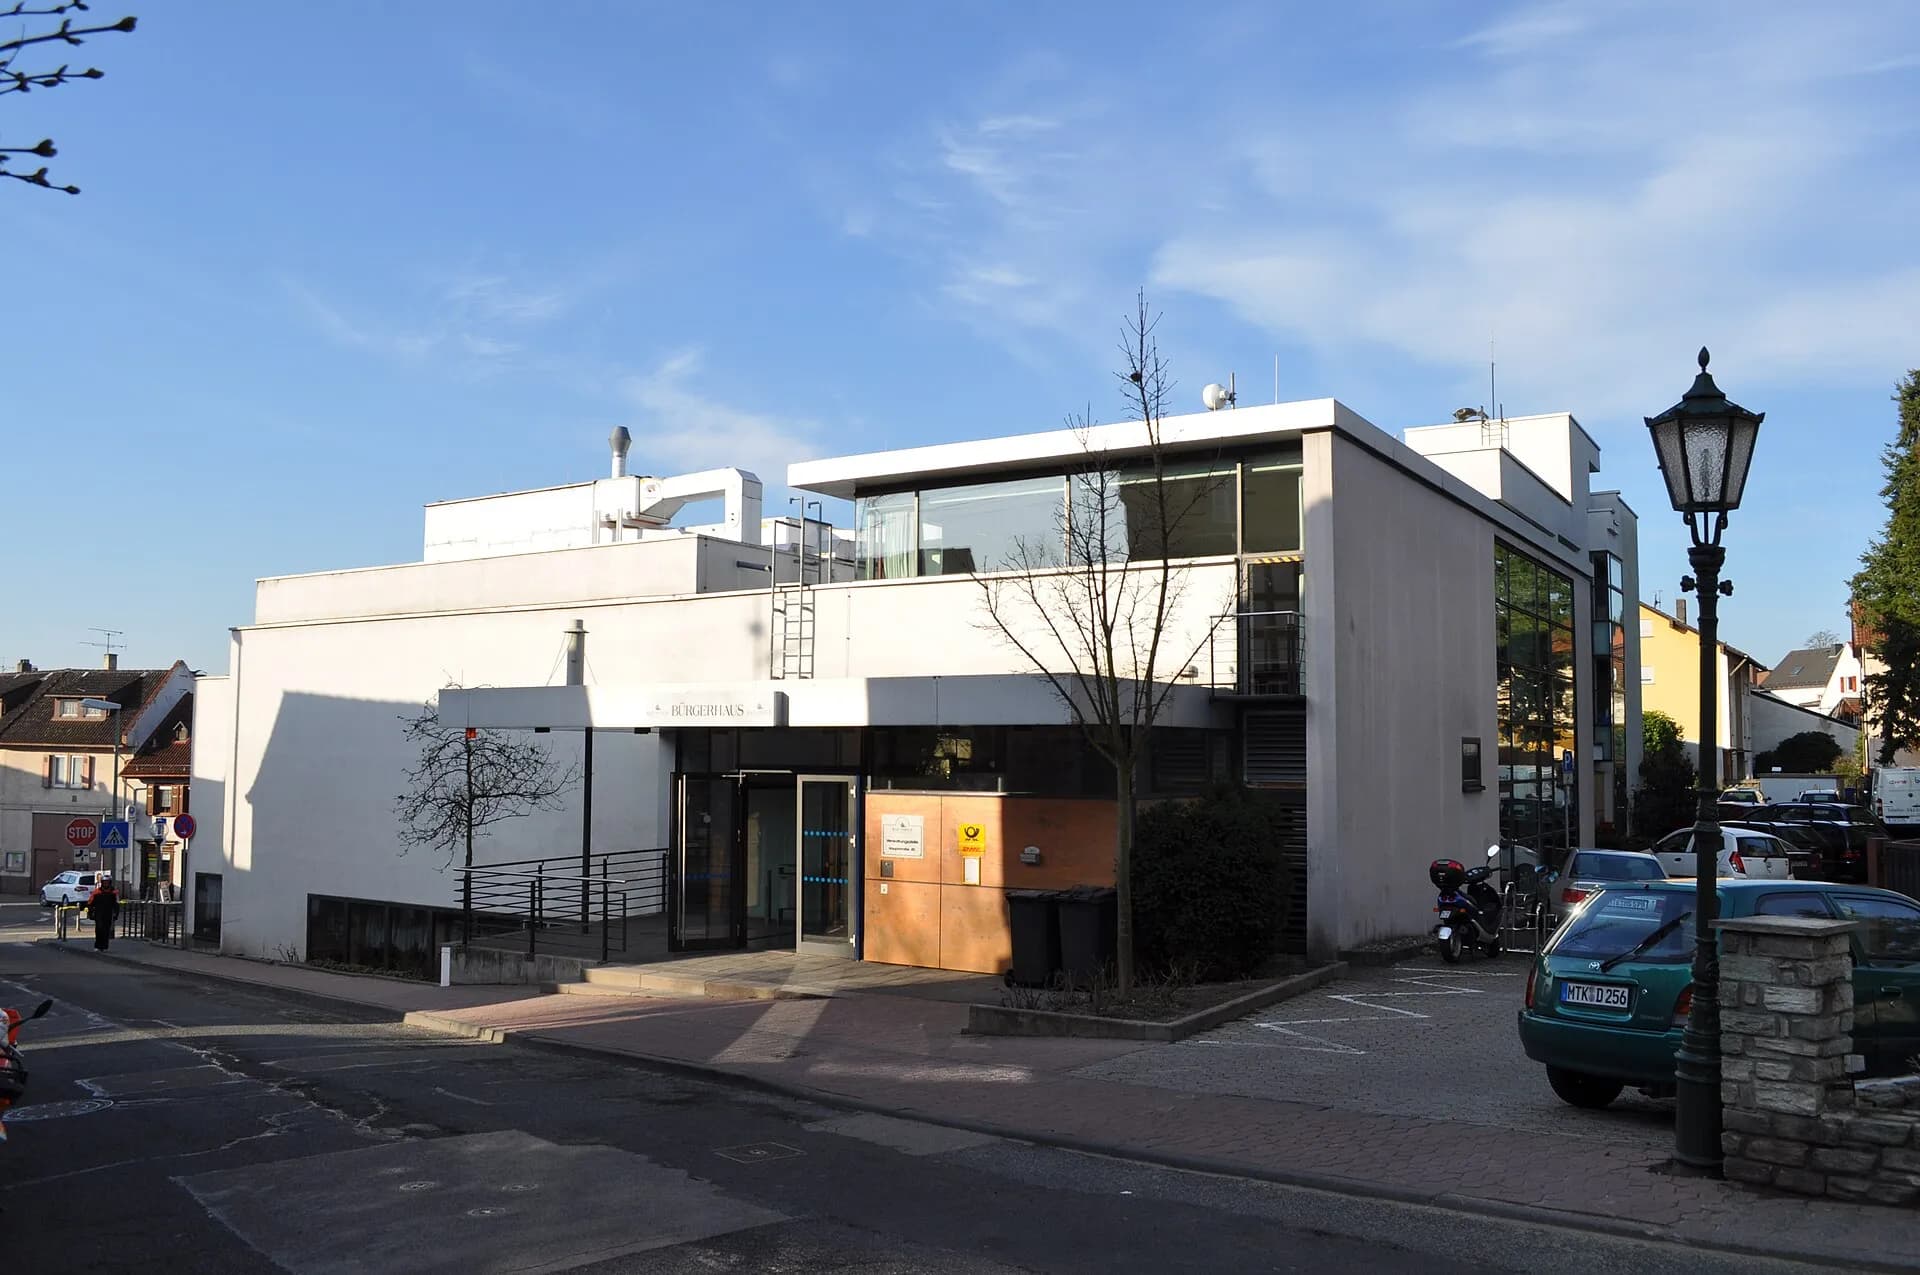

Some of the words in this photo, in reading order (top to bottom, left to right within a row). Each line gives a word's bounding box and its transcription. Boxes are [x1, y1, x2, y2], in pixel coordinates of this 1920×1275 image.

[671, 702, 744, 717] BÜRGERHAUS
[68, 826, 95, 839] STOP
[1567, 985, 1588, 1001] MTK
[1596, 987, 1604, 1003] D
[1606, 988, 1627, 1005] 256
